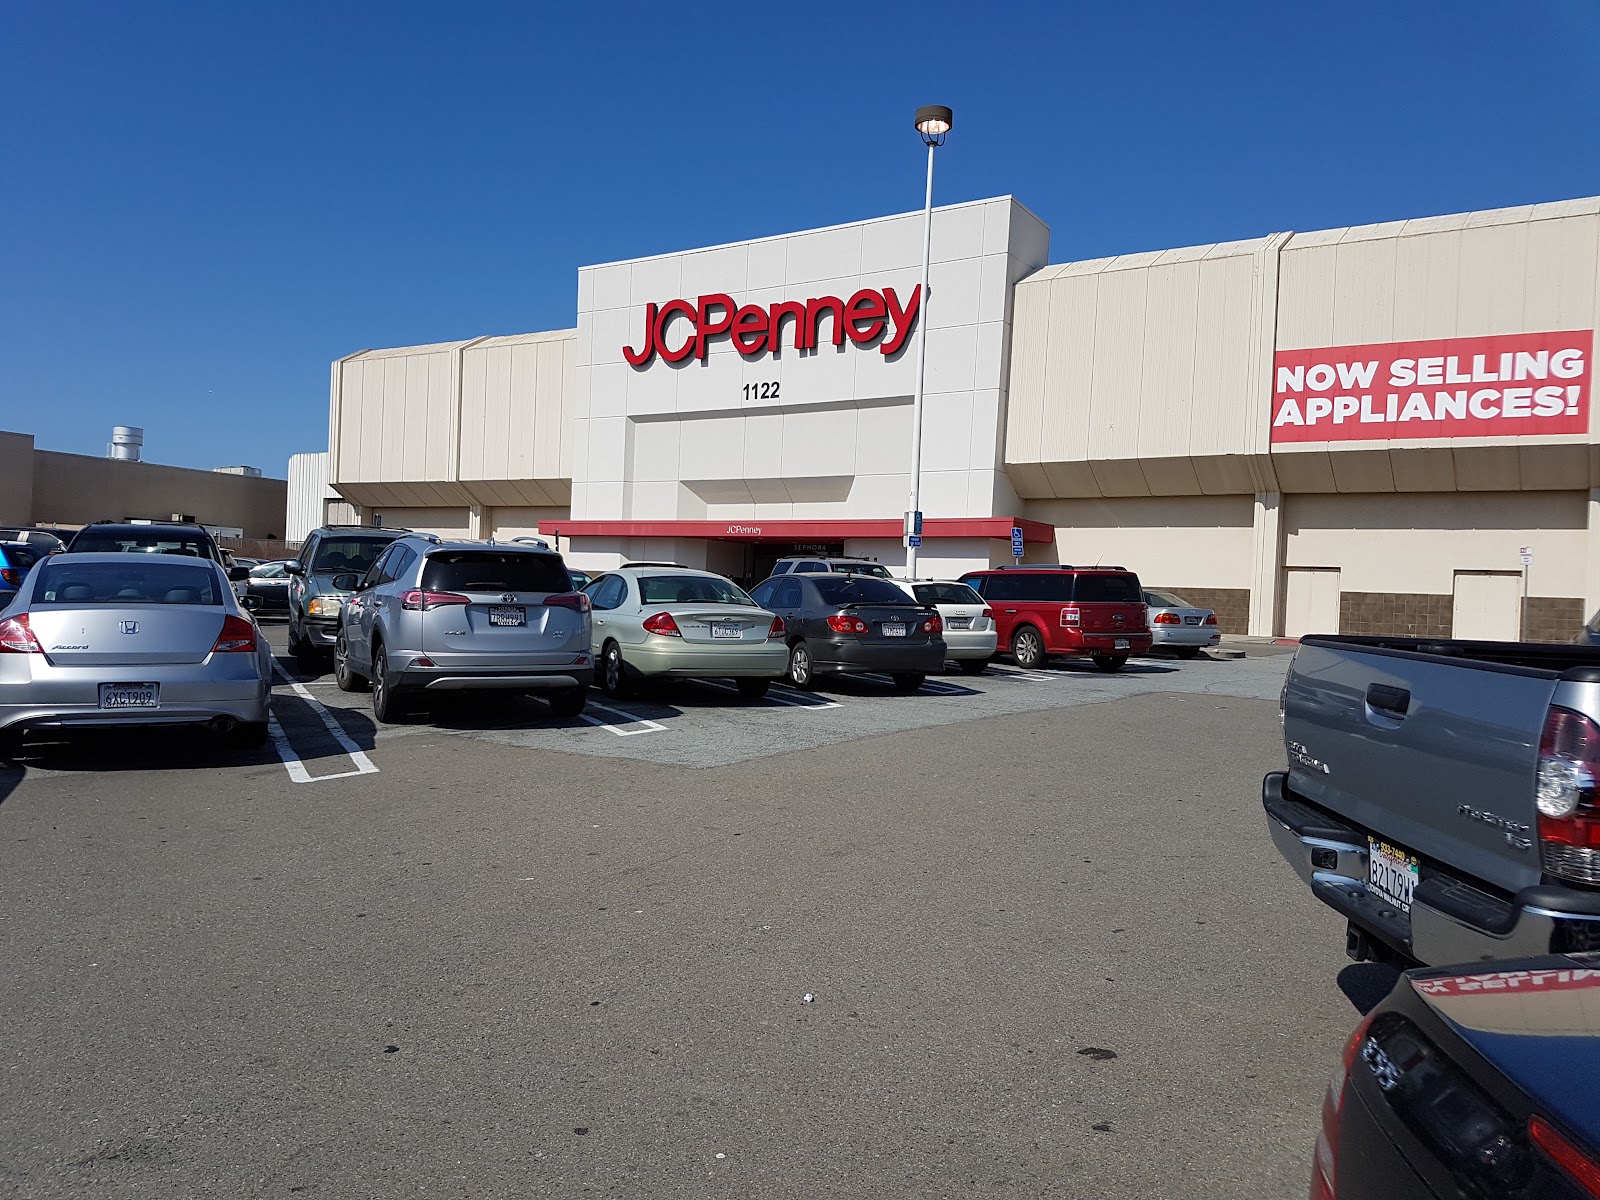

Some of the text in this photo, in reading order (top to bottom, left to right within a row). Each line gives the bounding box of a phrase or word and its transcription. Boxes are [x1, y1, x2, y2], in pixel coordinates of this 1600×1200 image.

[622, 283, 922, 366] JCPenney
[1277, 348, 1585, 393] NOW SELLING
[743, 381, 780, 400] 1122
[1273, 385, 1581, 427] APPLIANCES!
[726, 525, 762, 534] JCPenney
[793, 544, 827, 552] SEPHORA
